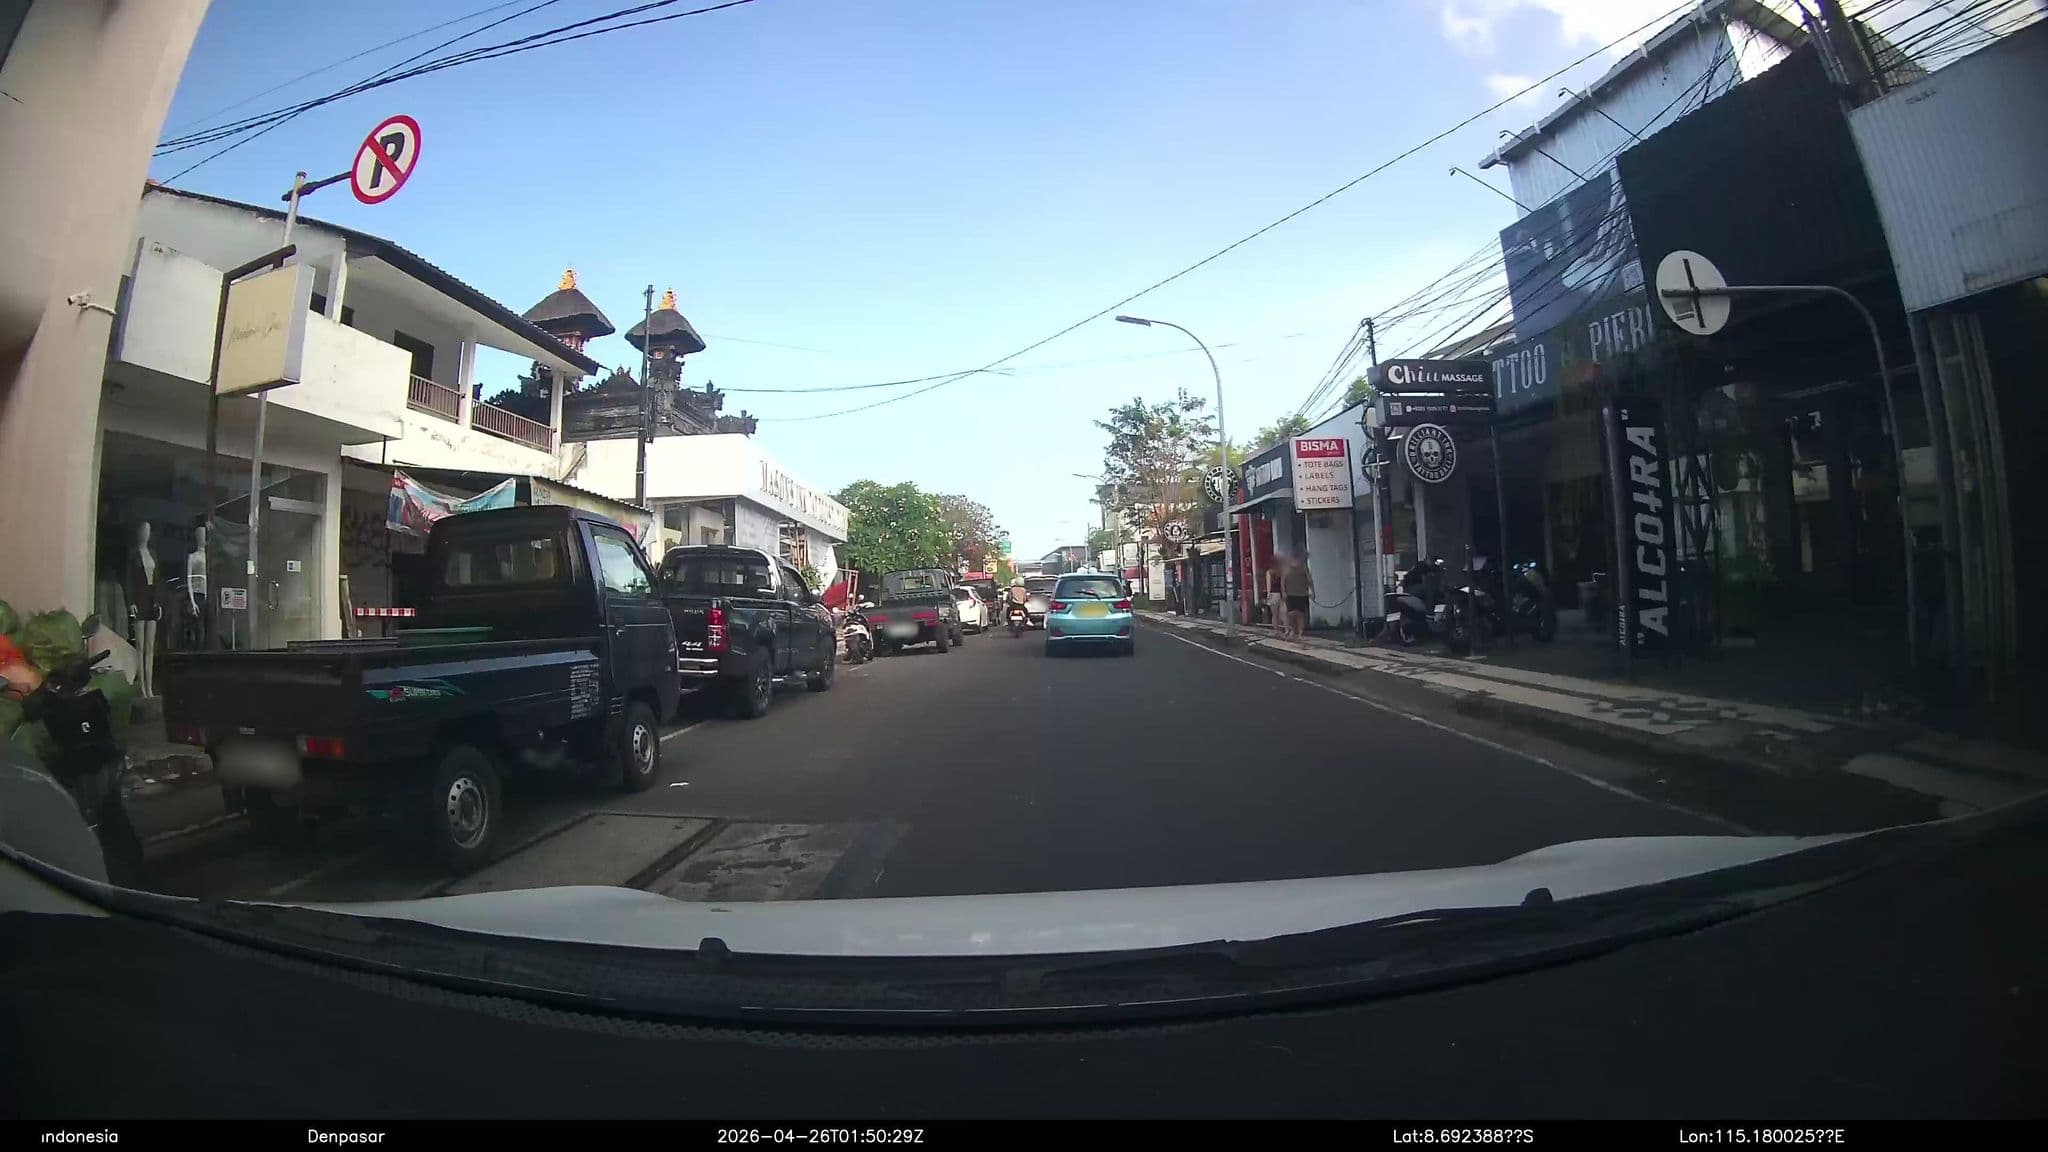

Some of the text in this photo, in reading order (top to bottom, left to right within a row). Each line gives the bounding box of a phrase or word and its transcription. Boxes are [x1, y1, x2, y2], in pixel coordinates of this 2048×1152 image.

[369, 132, 406, 189] P
[1388, 365, 1484, 384] Chill MASSAGE
[1300, 440, 1339, 452] BISMA
[1323, 460, 1344, 468] BAGS
[1305, 472, 1334, 480] LABELS
[1328, 484, 1348, 492] TAGS
[1306, 497, 1340, 505] STICKERS
